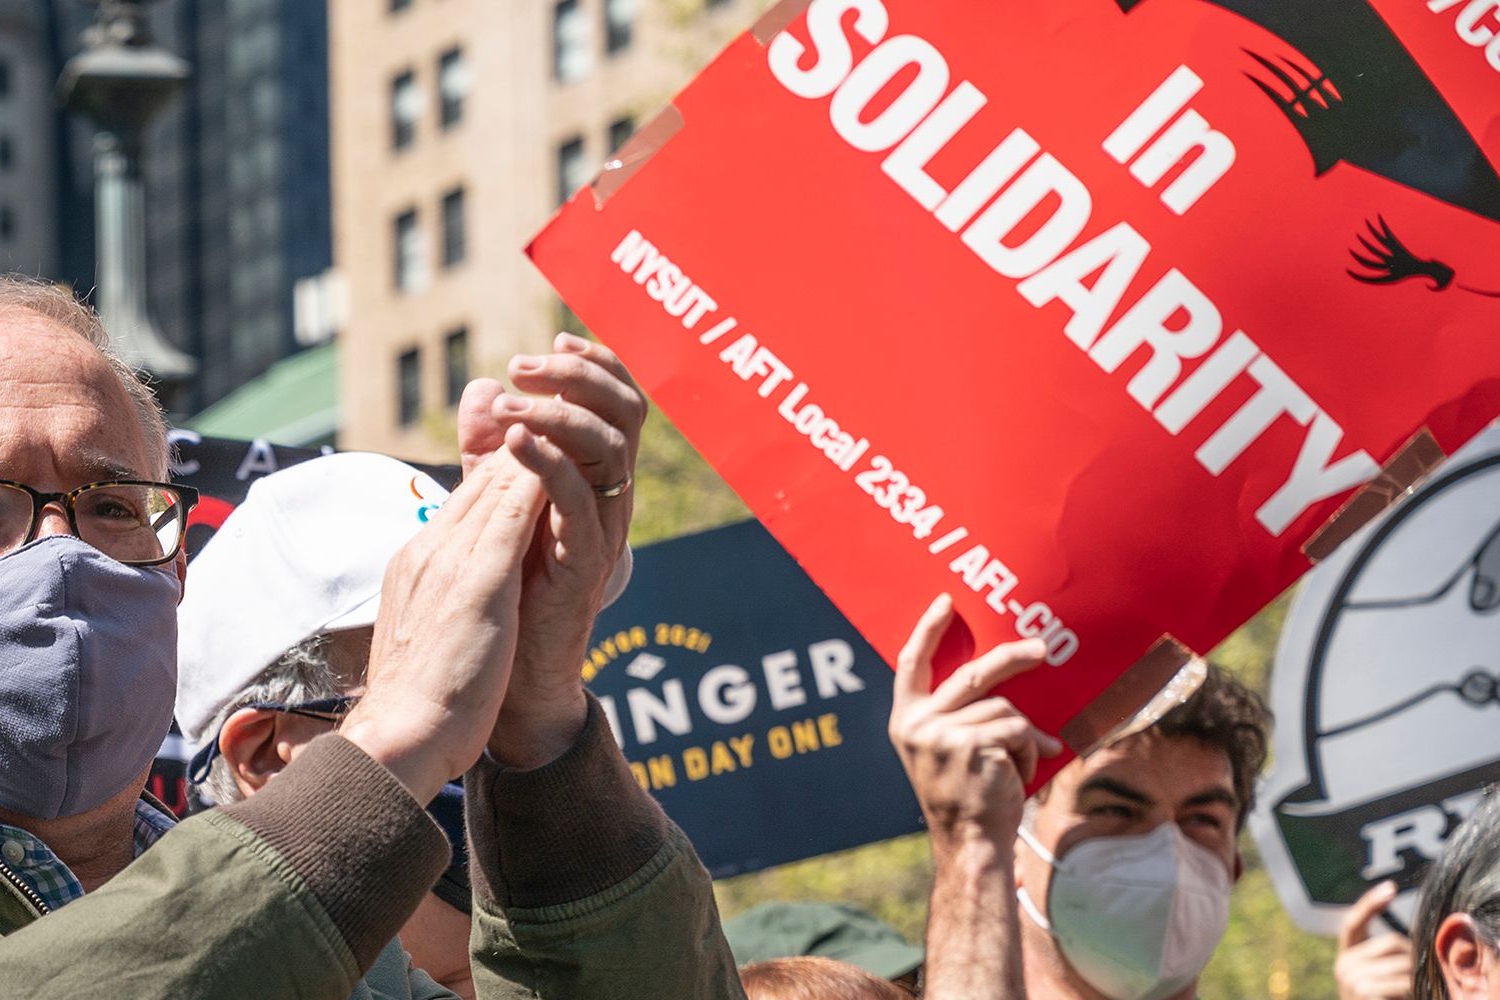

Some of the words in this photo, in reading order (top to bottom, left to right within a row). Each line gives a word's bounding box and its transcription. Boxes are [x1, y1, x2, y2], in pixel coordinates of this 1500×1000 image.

[1101, 63, 1236, 216] In
[768, 0, 1381, 537] SOLIDARITY
[610, 229, 718, 329] NYSUT
[699, 316, 738, 345] /
[719, 333, 794, 398] AFT
[778, 382, 870, 472] Local
[855, 455, 944, 539] 2334
[928, 526, 969, 555] /
[949, 544, 1079, 667] AFL-CIO
[597, 638, 866, 749] INGER
[654, 623, 712, 654] 2021
[683, 733, 754, 781] DAY
[767, 713, 843, 760] ONE
